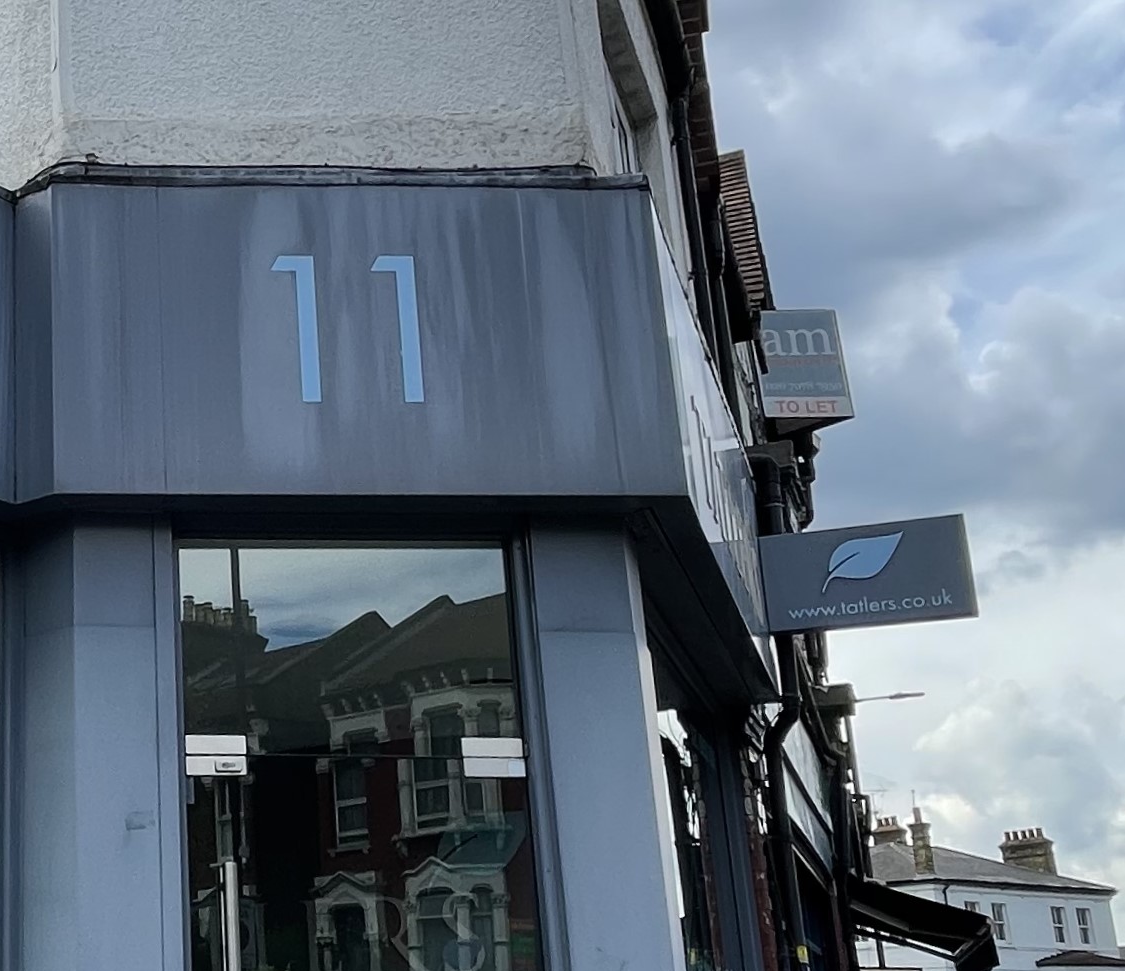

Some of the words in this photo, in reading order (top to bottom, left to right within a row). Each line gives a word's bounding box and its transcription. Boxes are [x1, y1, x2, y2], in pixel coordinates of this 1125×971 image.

[269, 255, 425, 403] 11
[775, 400, 799, 414] TO
[805, 400, 838, 414] LET
[788, 588, 954, 619] www.tatlers.co.uk
